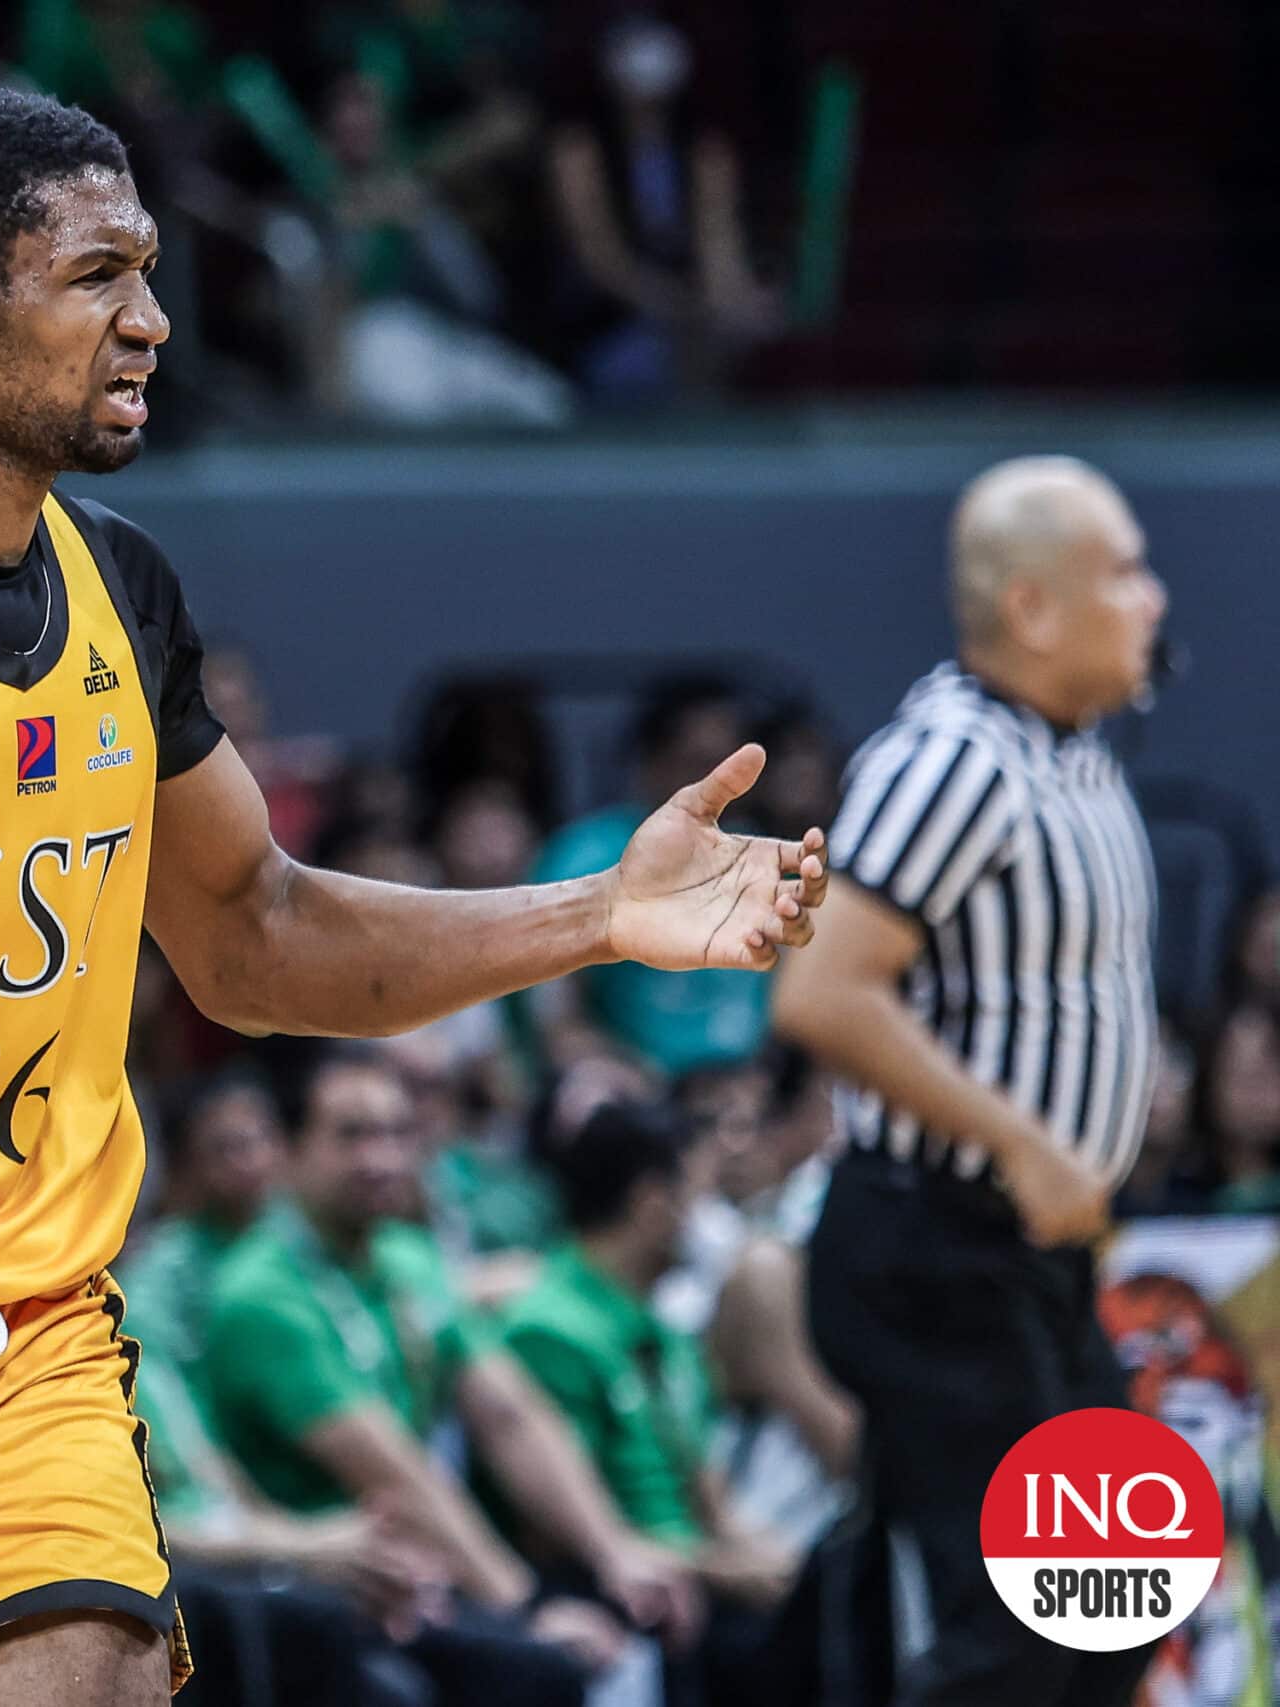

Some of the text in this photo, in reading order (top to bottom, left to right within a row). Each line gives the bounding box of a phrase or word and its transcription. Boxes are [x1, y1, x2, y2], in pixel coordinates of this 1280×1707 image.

[83, 670, 120, 696] DELTA
[87, 749, 133, 771] COCOLIFE
[17, 779, 57, 797] PETRON
